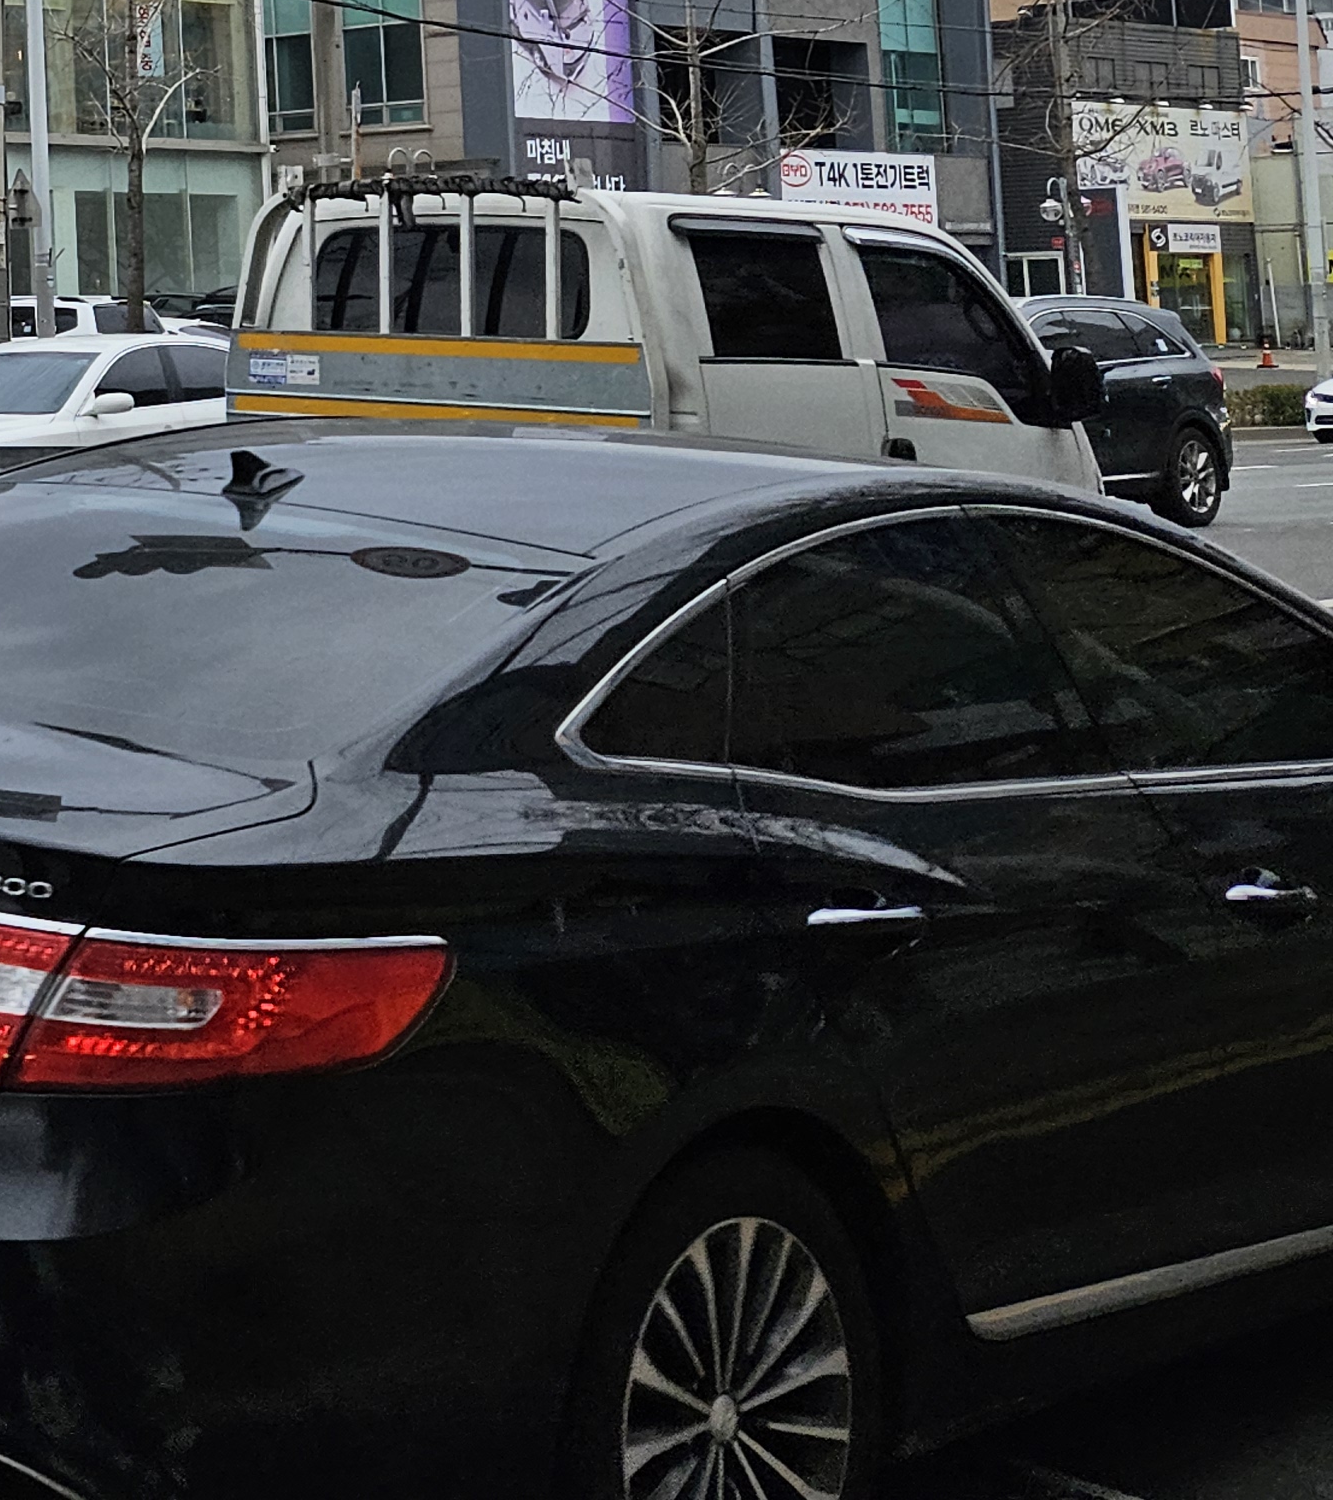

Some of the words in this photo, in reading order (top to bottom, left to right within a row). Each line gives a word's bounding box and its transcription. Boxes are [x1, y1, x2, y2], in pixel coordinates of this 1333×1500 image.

[1136, 119, 1179, 138] XM3
[526, 138, 571, 164] 마침내
[782, 163, 808, 178] BYD
